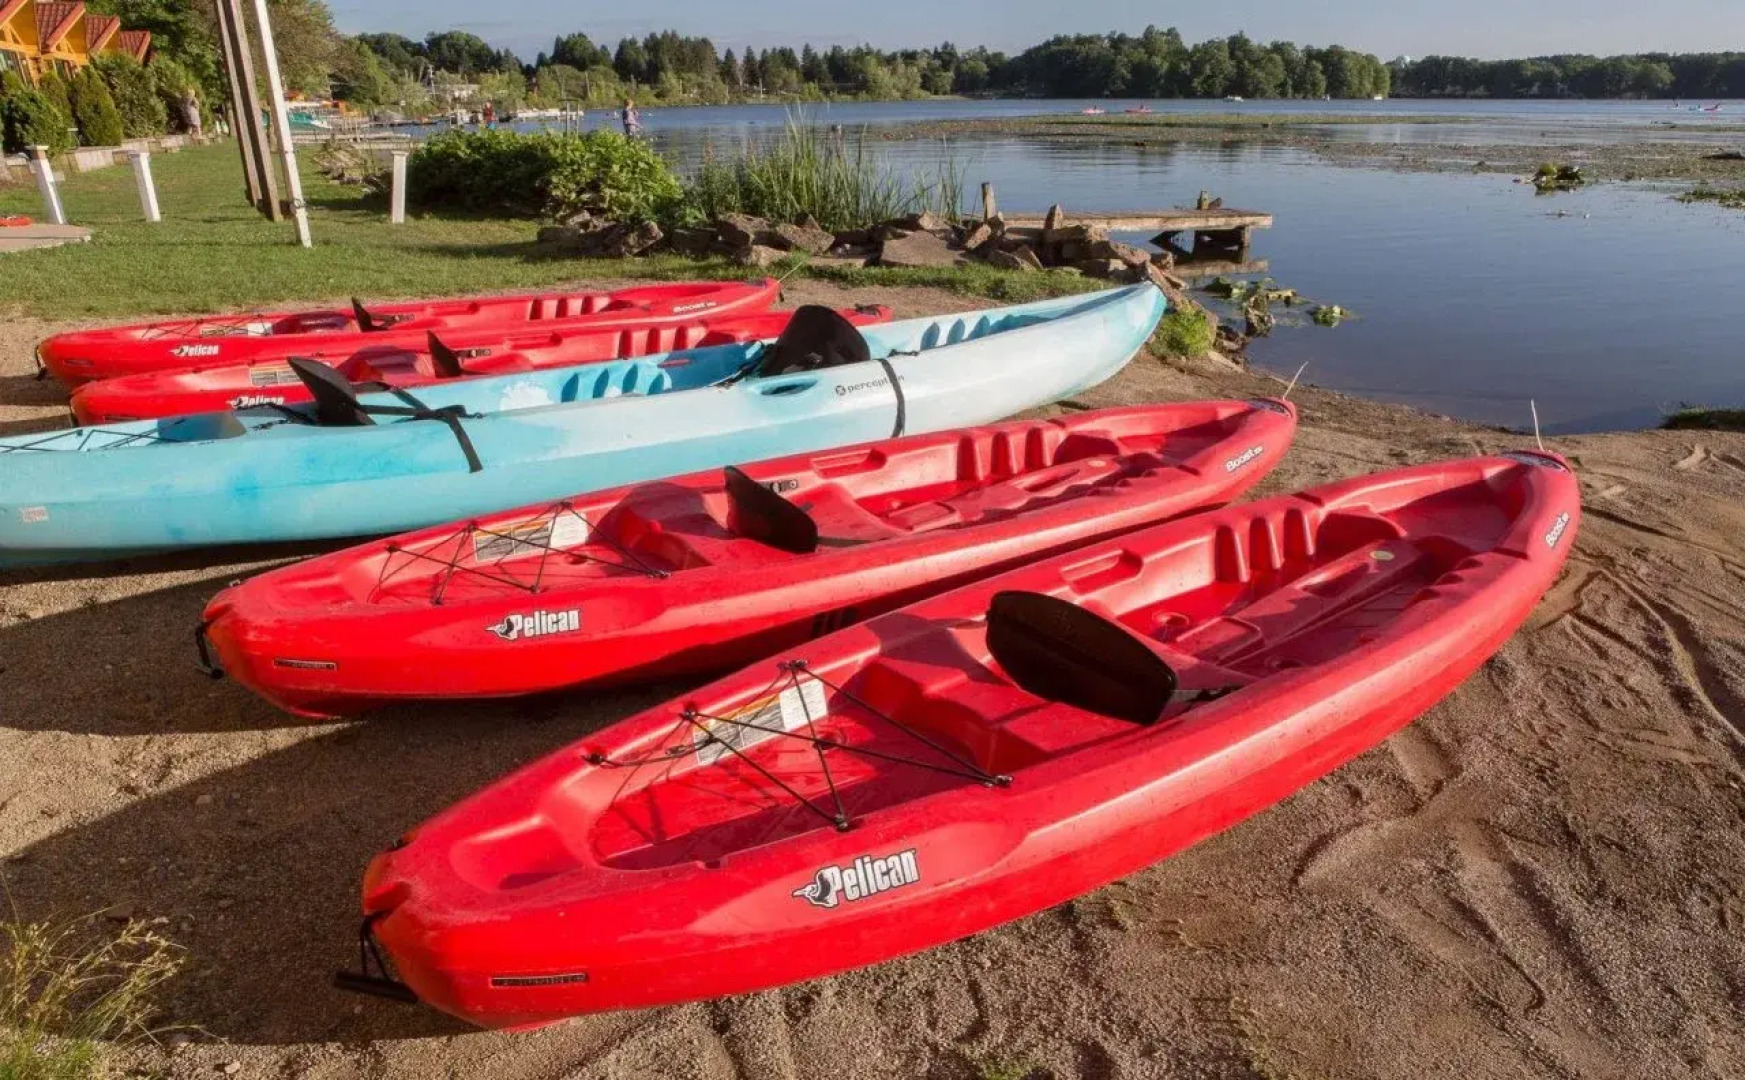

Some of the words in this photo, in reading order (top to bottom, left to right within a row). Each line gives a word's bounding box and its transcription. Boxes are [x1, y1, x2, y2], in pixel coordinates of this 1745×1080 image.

[179, 344, 219, 357] Pelican
[847, 375, 905, 393] perceptn
[1226, 448, 1255, 471] Boost
[504, 610, 580, 639] Pelican
[816, 850, 919, 907] Pelican
